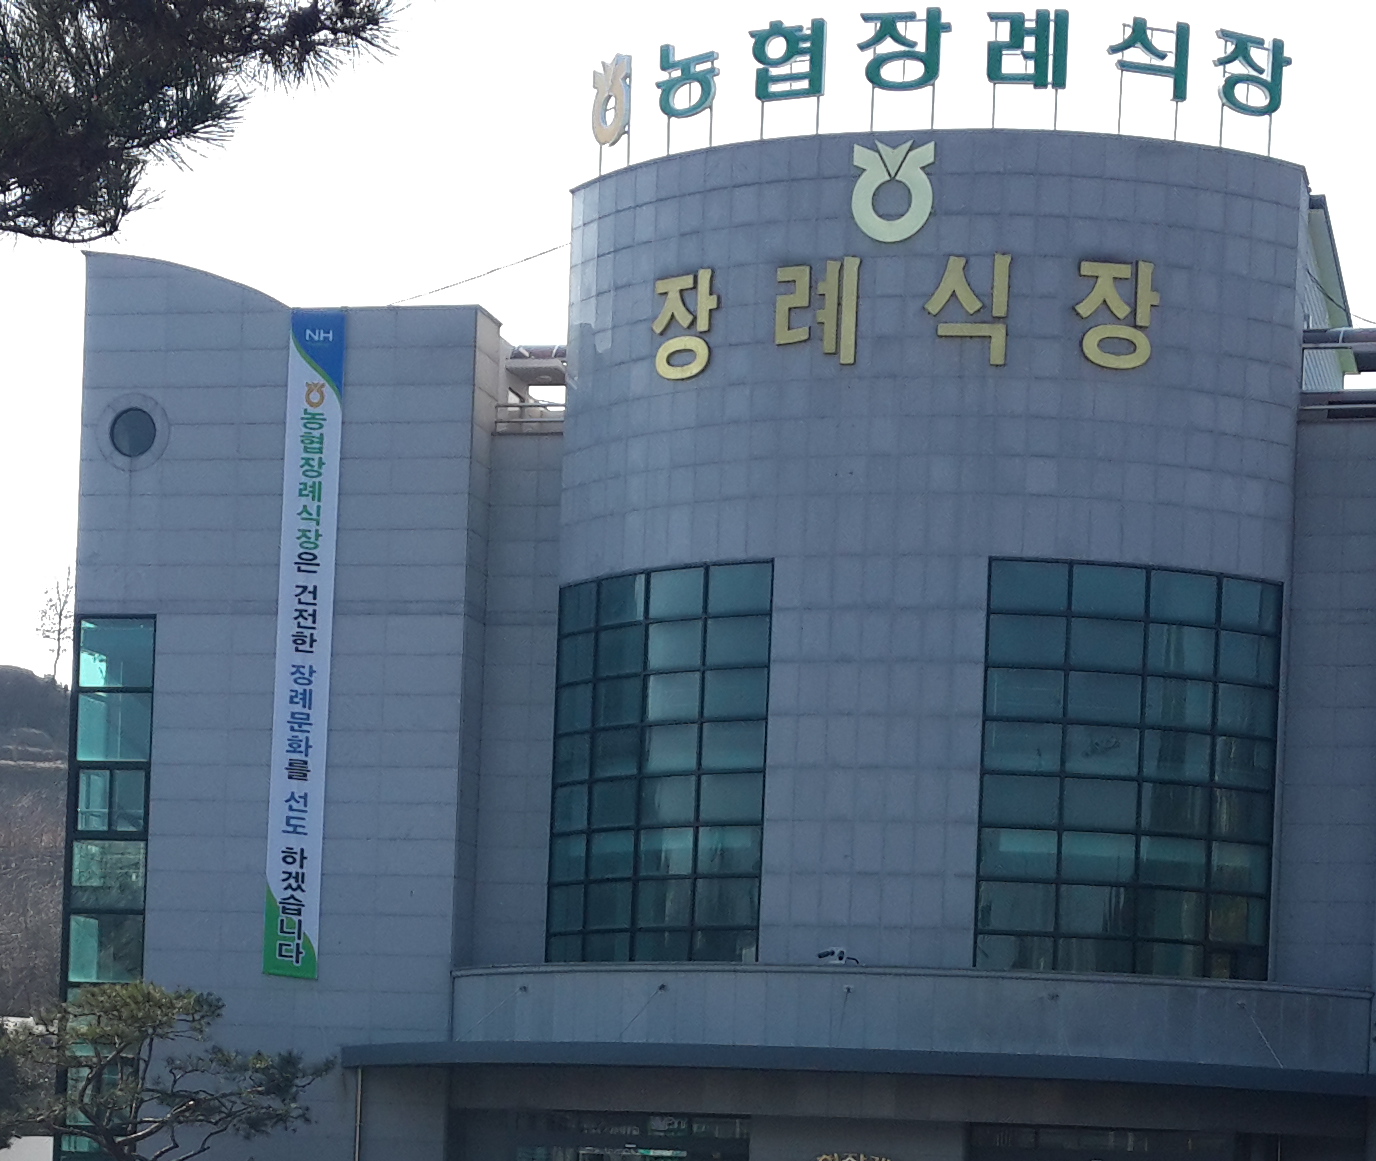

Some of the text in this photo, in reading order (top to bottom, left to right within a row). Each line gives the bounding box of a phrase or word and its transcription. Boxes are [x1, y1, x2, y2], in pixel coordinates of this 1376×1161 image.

[305, 328, 334, 342] NH
[290, 584, 318, 654] 건전한
[284, 664, 317, 782] 장례문화를
[281, 790, 309, 837] 선도
[276, 847, 308, 965] 하겠습니다
